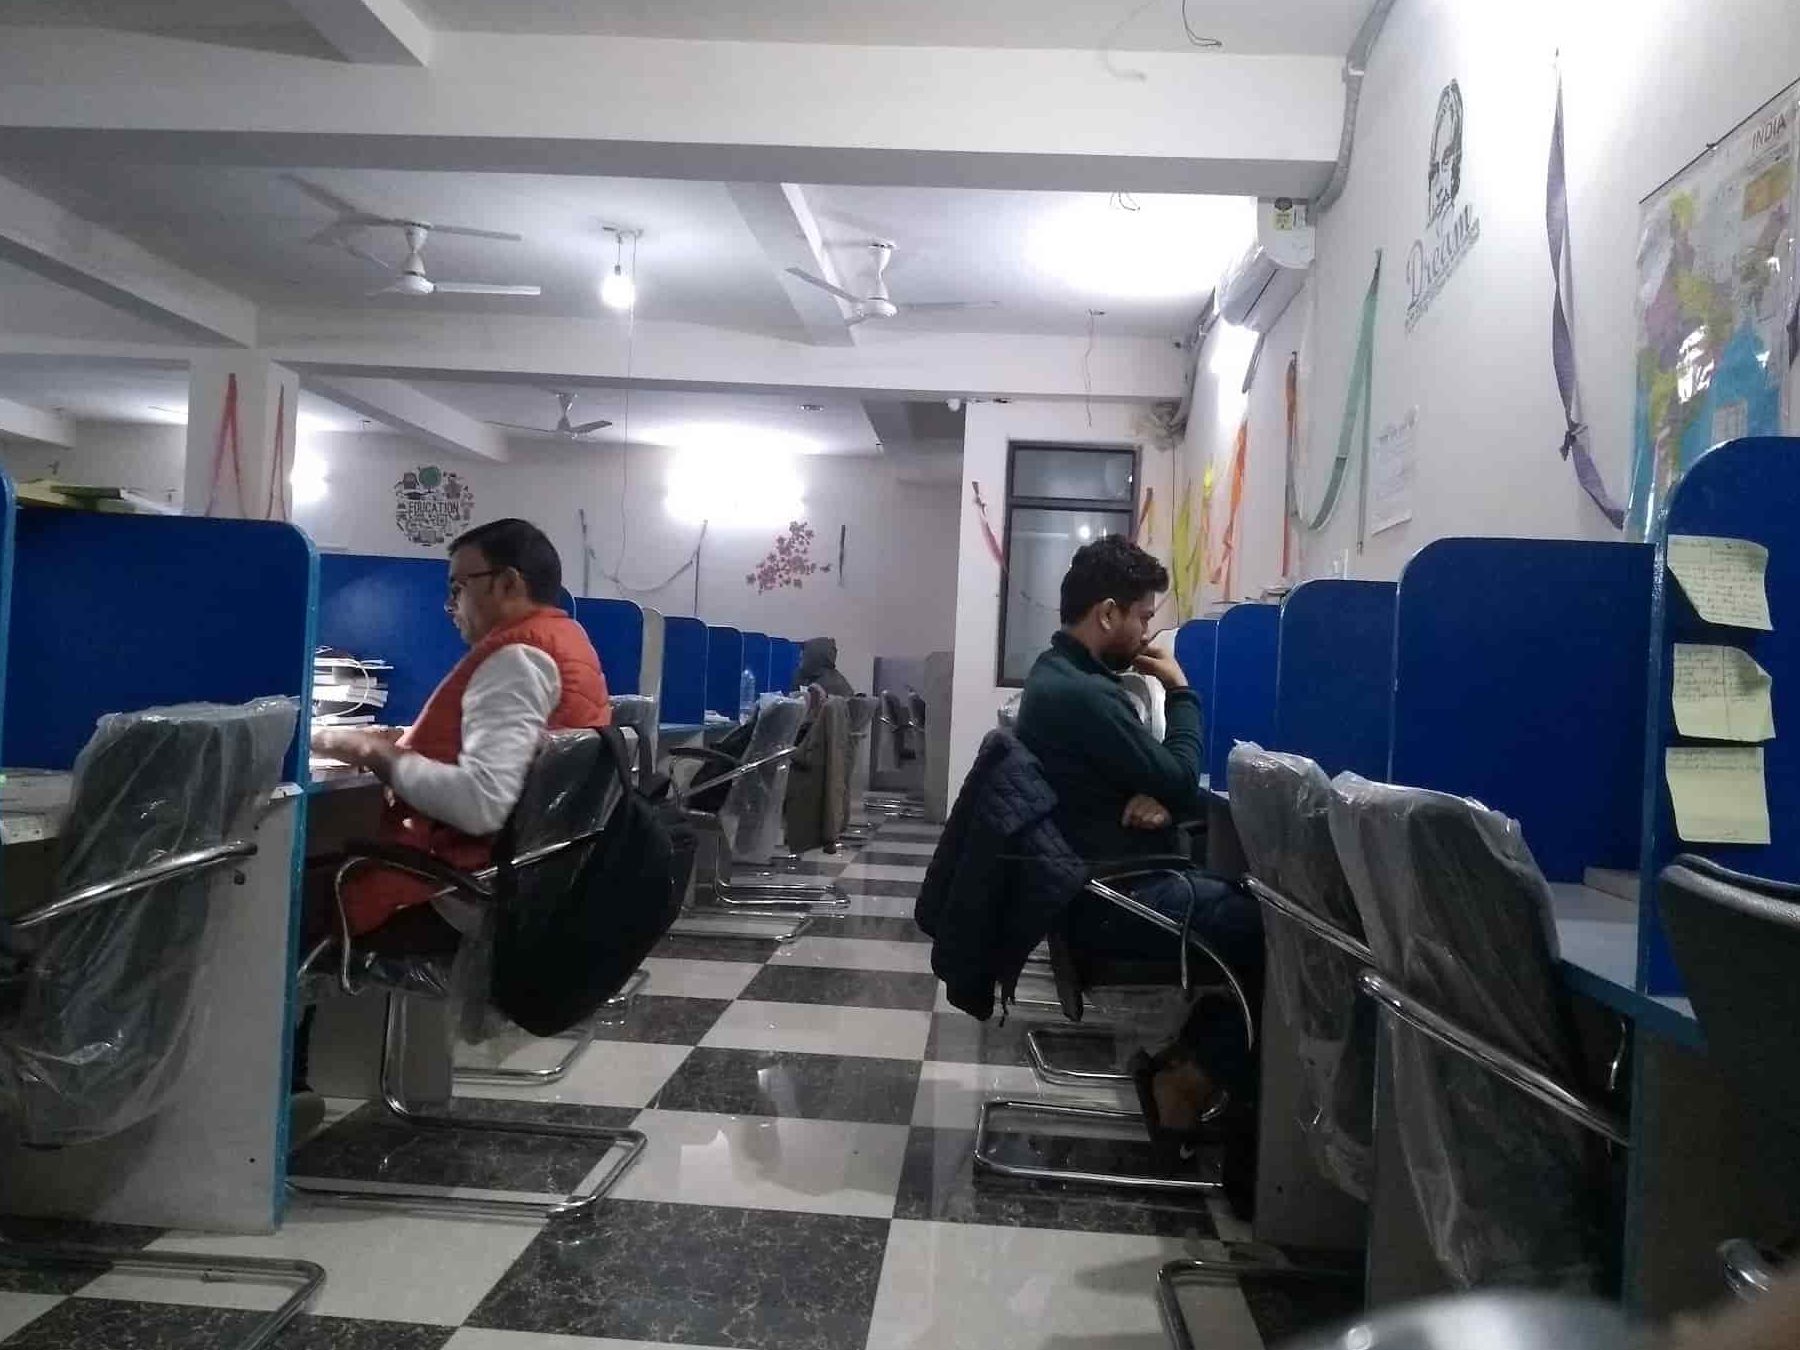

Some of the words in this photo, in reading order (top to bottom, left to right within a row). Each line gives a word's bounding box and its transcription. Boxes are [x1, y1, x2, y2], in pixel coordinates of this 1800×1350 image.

[1752, 112, 1787, 151] INDIA
[1406, 204, 1472, 310] Dream
[407, 500, 459, 519] EDUCATION
